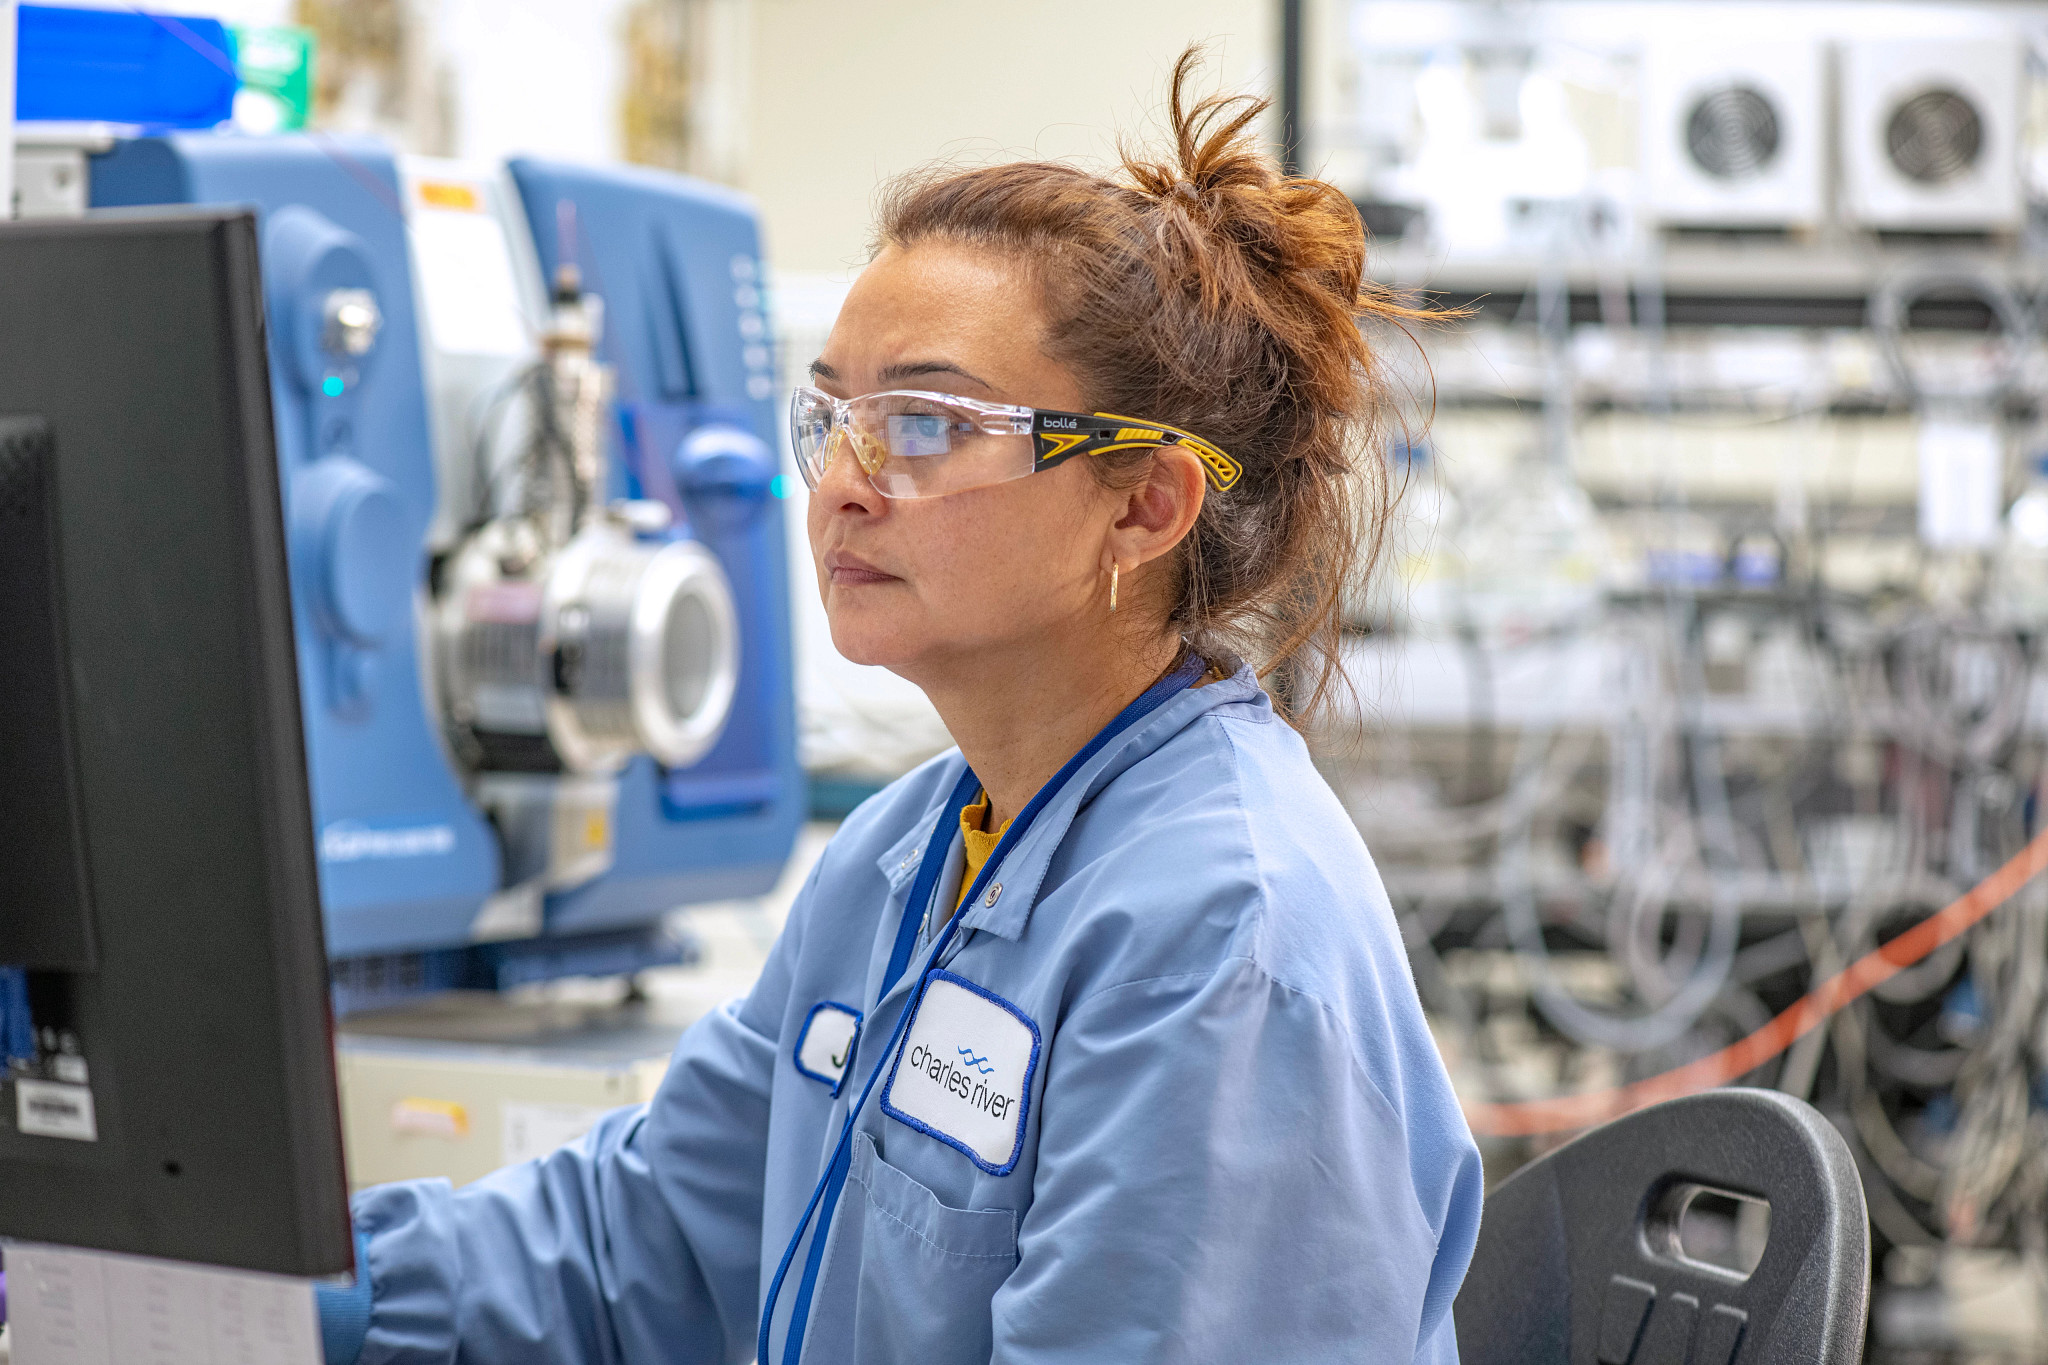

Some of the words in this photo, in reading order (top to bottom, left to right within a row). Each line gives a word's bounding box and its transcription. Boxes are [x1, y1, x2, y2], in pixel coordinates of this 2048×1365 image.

[1043, 416, 1077, 429] bollé
[911, 1044, 971, 1098] charles
[971, 1079, 1015, 1120] river
